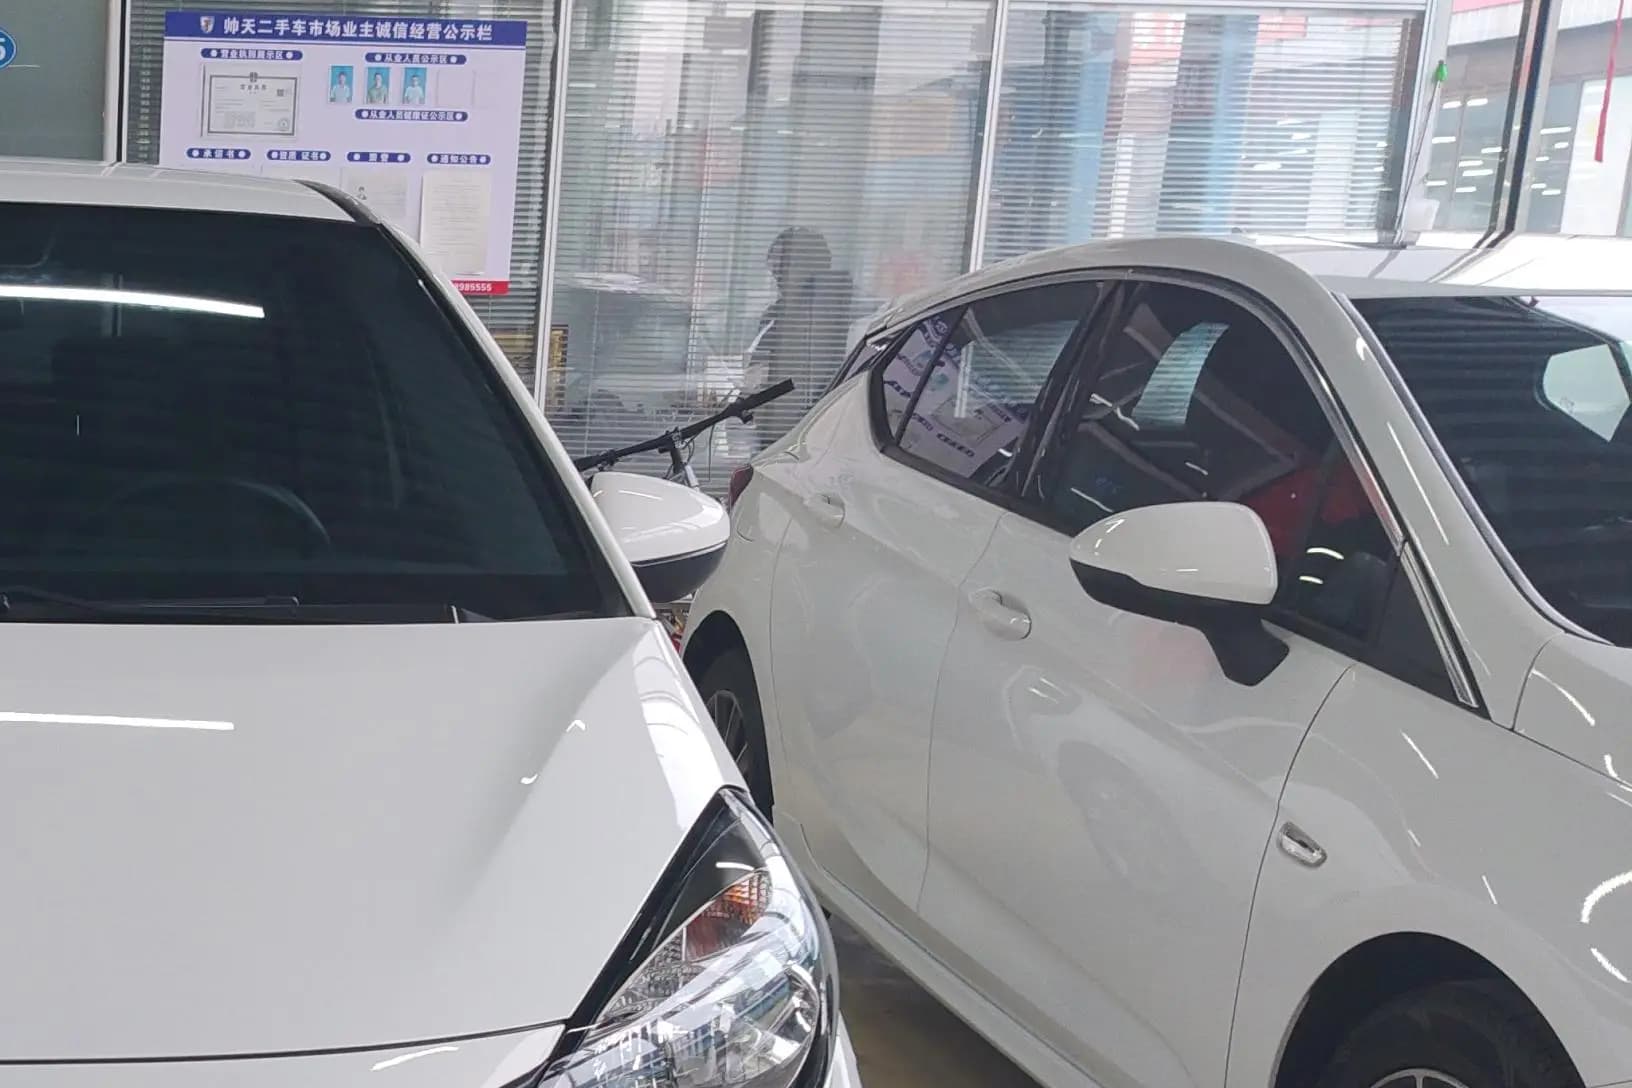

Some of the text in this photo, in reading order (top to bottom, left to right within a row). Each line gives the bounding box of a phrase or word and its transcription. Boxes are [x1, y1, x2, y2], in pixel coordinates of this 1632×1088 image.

[224, 17, 492, 41] 帅天二手车市场业主诚信经营公示栏
